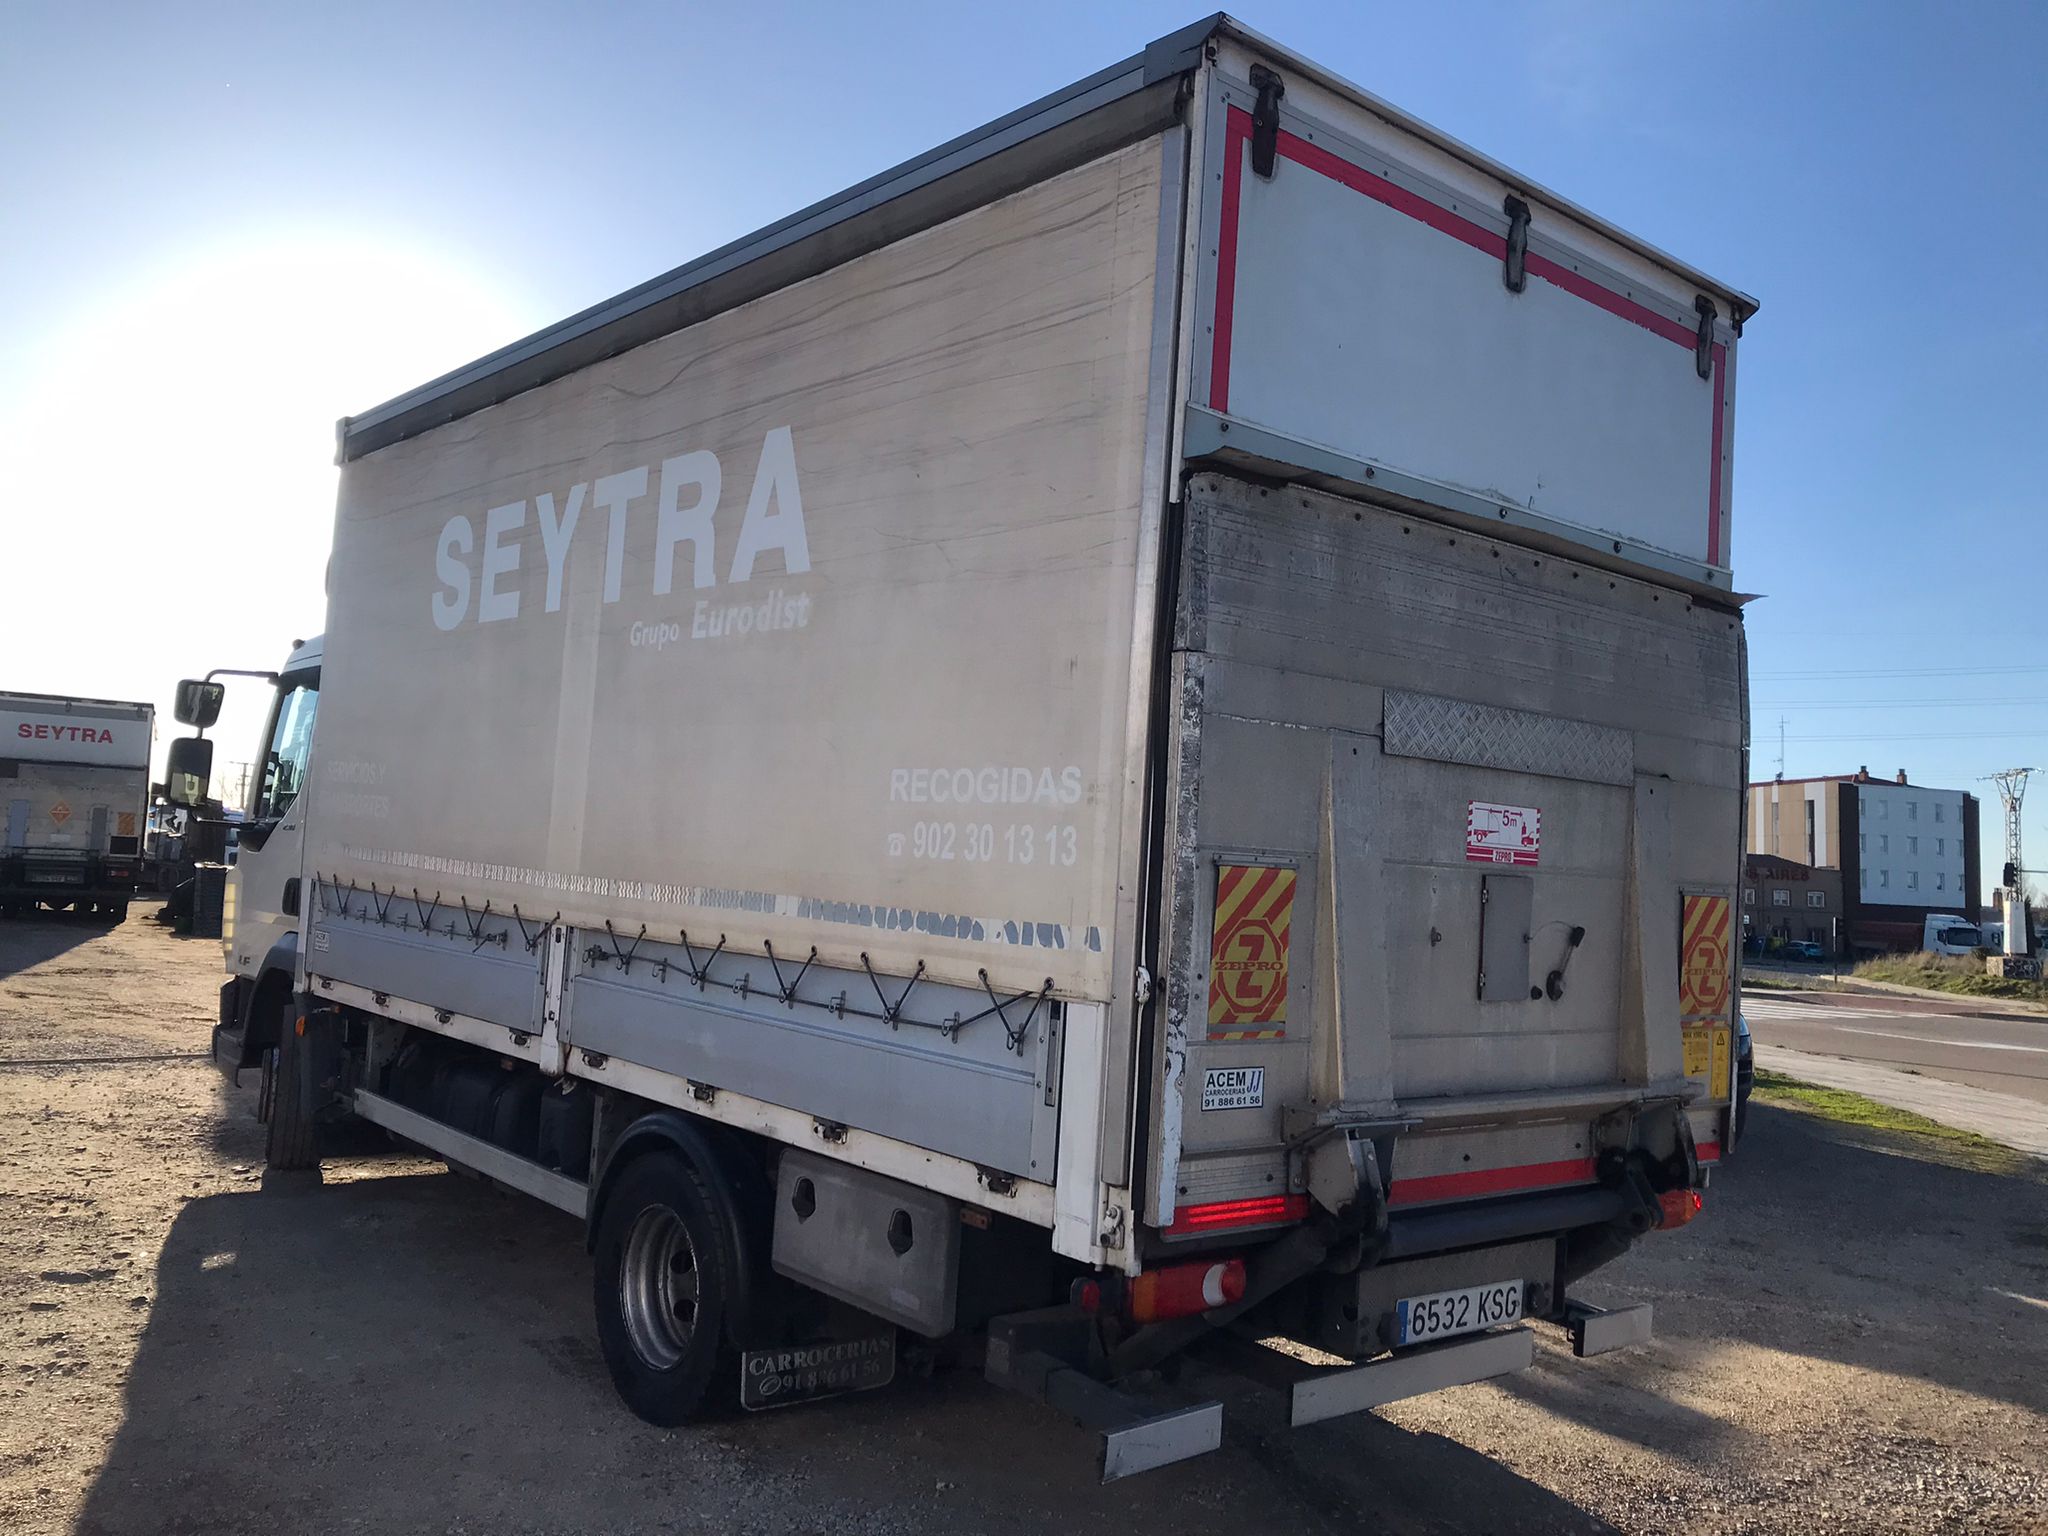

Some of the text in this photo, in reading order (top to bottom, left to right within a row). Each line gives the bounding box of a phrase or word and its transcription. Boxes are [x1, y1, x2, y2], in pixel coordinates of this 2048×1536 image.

[431, 425, 811, 632] SEYTRA
[630, 588, 814, 650] Grupo Eurodist
[18, 723, 113, 744] SEYTRA
[889, 765, 1083, 804] RECOGIDAS
[913, 821, 1078, 867] 902 30 13 13
[1215, 960, 1284, 972] ZEPRO
[1684, 967, 1727, 976] ZEPRO
[1204, 1087, 1246, 1097] CARROCERIAS
[1206, 1071, 1246, 1088] ACEM
[1204, 1095, 1260, 1107] 91 886 61 56
[1412, 1286, 1517, 1336] 6532 KSG
[749, 1336, 890, 1376] CARROCERIAS
[782, 1373, 801, 1392] 91
[840, 1362, 857, 1382] 61
[863, 1358, 880, 1377] 56
